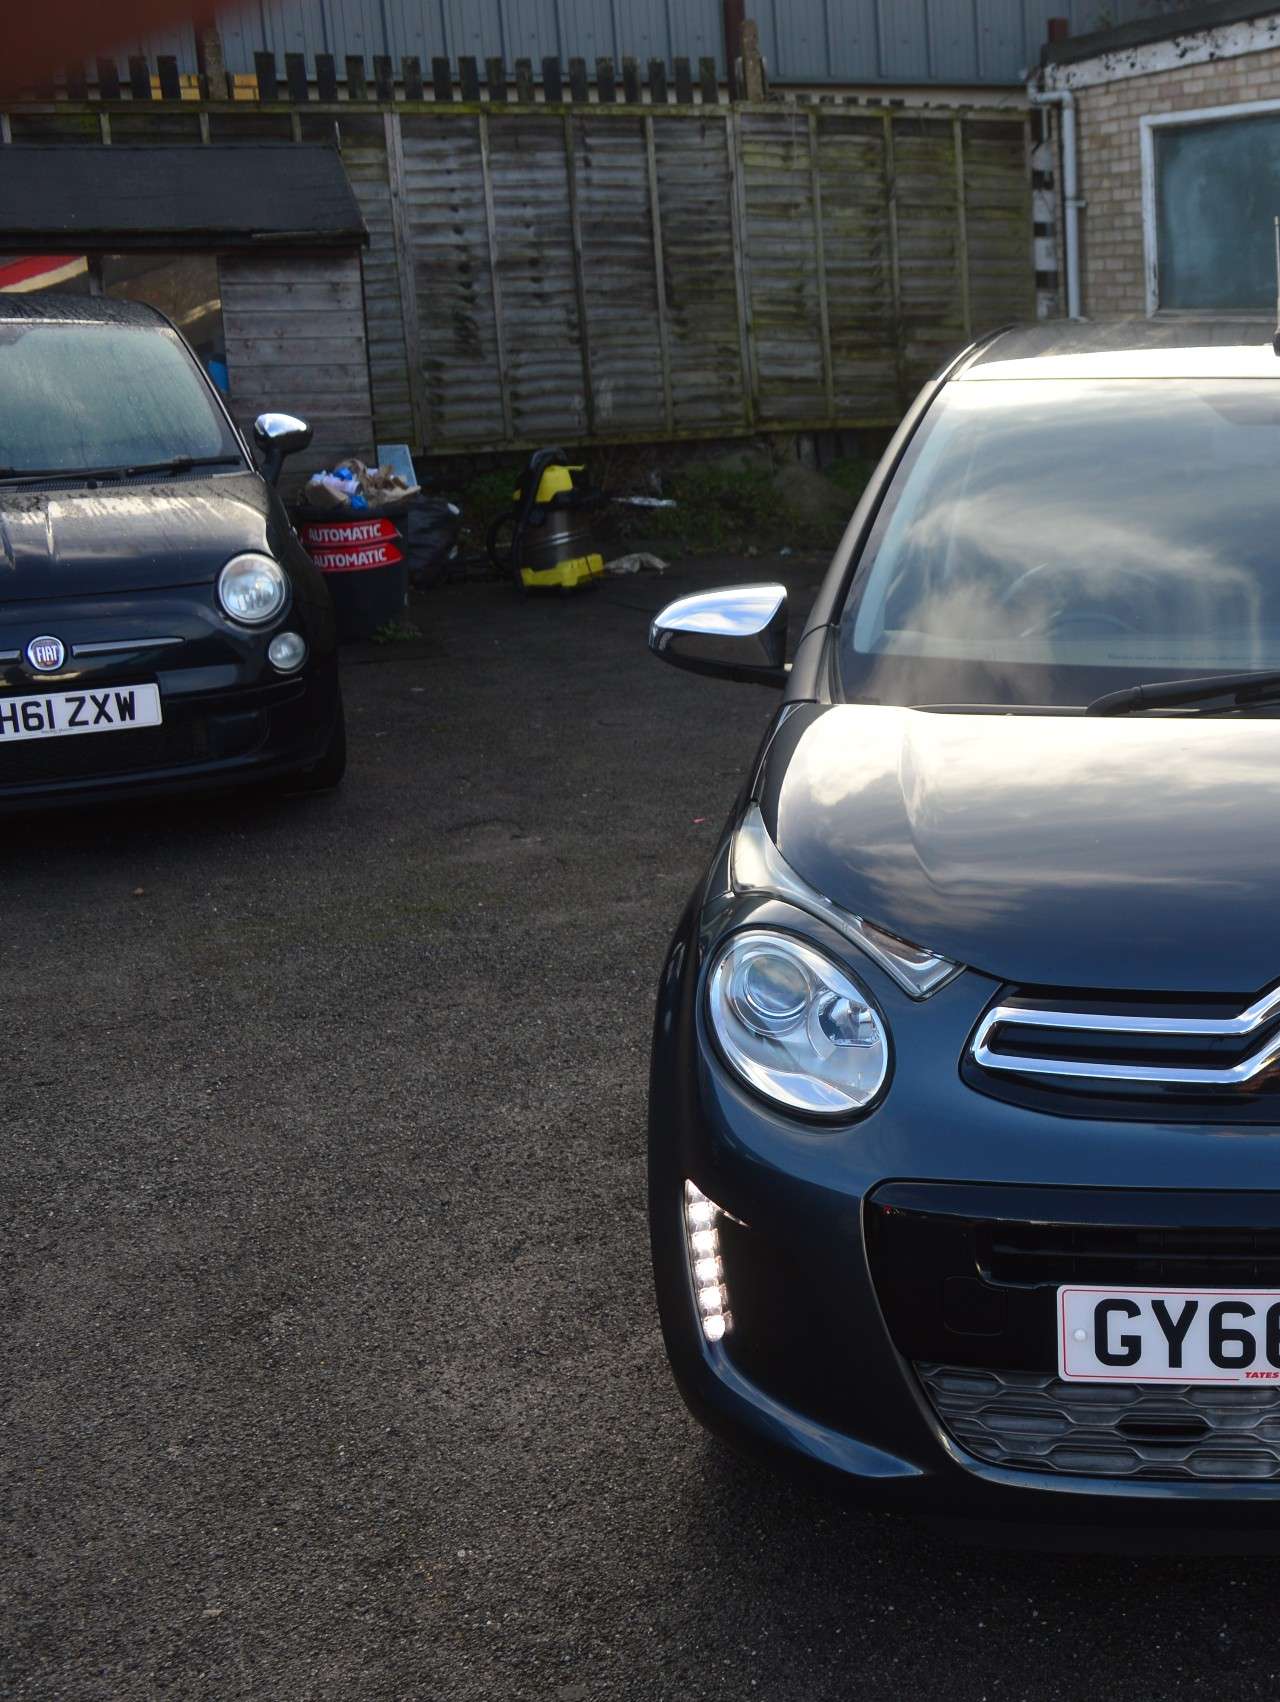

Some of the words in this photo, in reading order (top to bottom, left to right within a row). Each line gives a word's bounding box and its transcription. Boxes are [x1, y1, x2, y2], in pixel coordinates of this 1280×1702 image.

[309, 524, 381, 541] AUTOMATIC
[314, 548, 387, 567] AUTOMATIC
[36, 645, 59, 662] FIAT
[0, 700, 55, 735] H61
[65, 691, 136, 727] ZXW
